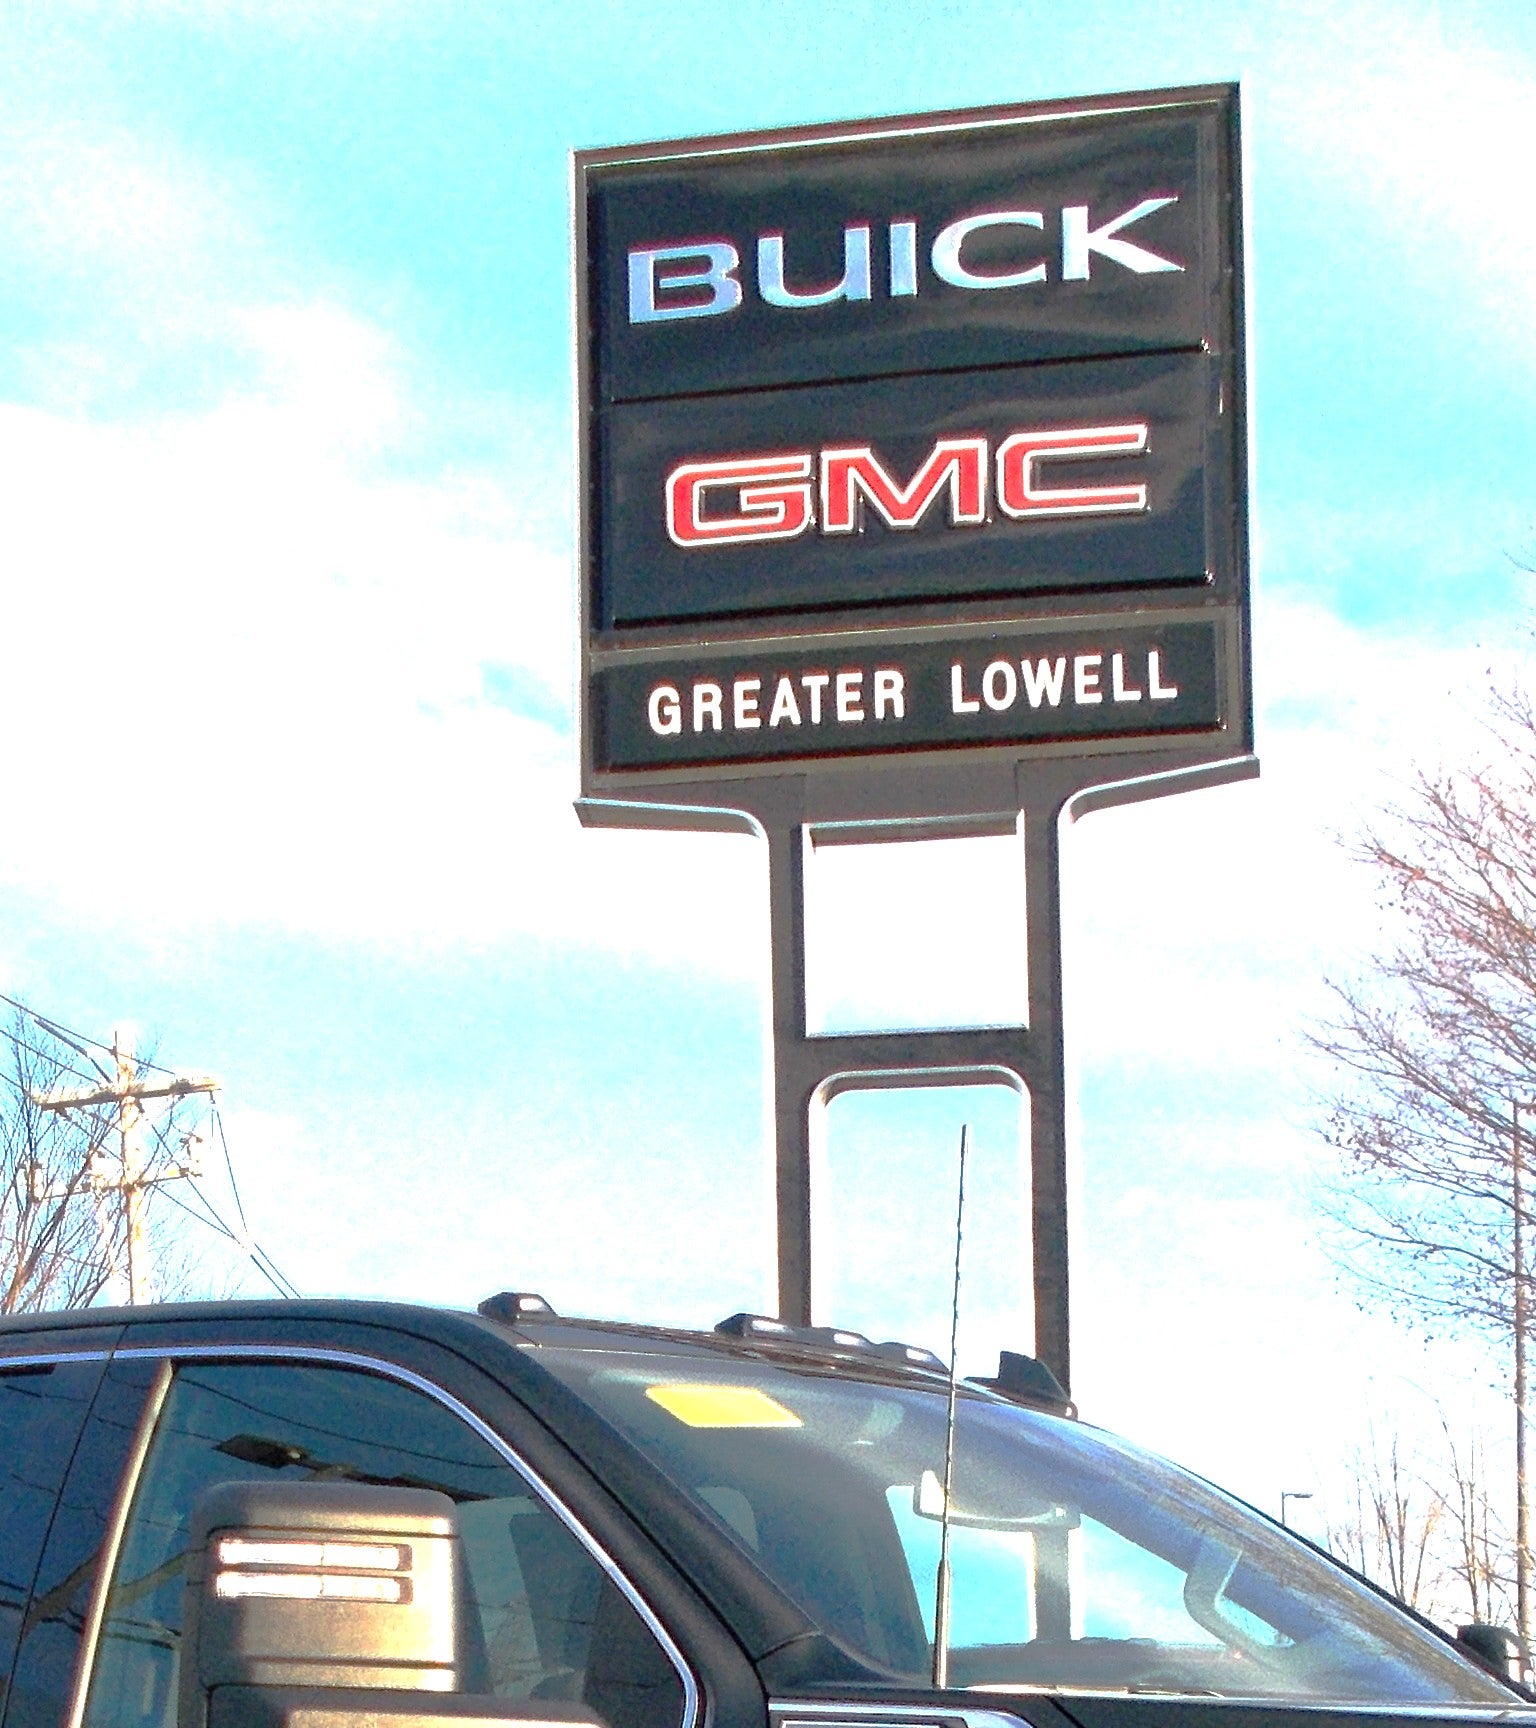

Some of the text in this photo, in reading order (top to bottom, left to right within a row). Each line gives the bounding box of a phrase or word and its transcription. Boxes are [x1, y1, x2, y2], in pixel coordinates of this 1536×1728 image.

[627, 197, 1186, 324] BUICK
[665, 423, 1151, 548] GMC
[648, 650, 1178, 735] GREATER LOWELL
